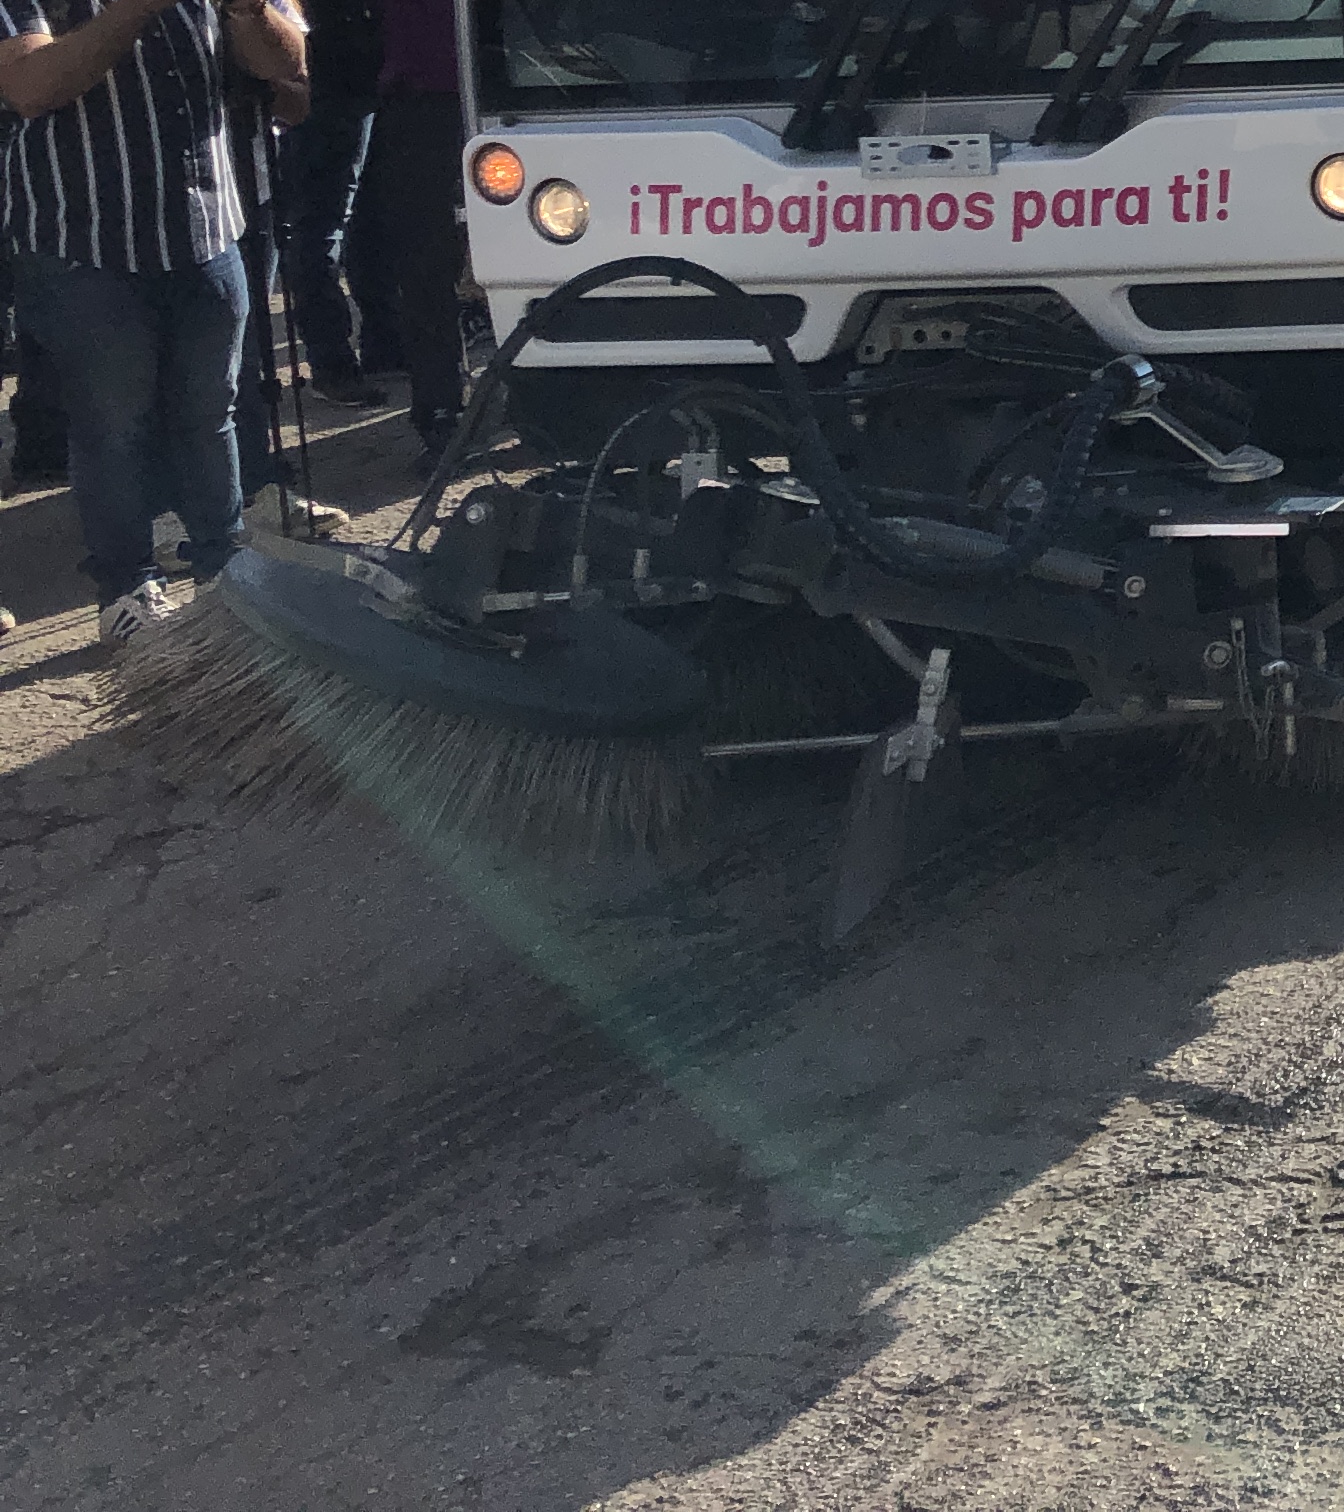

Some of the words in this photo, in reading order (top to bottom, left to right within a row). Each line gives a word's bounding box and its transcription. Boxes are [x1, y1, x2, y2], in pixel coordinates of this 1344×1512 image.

[629, 180, 996, 248] ¡Trabajamos
[1012, 182, 1152, 243] para
[1168, 168, 1232, 224] ti!
